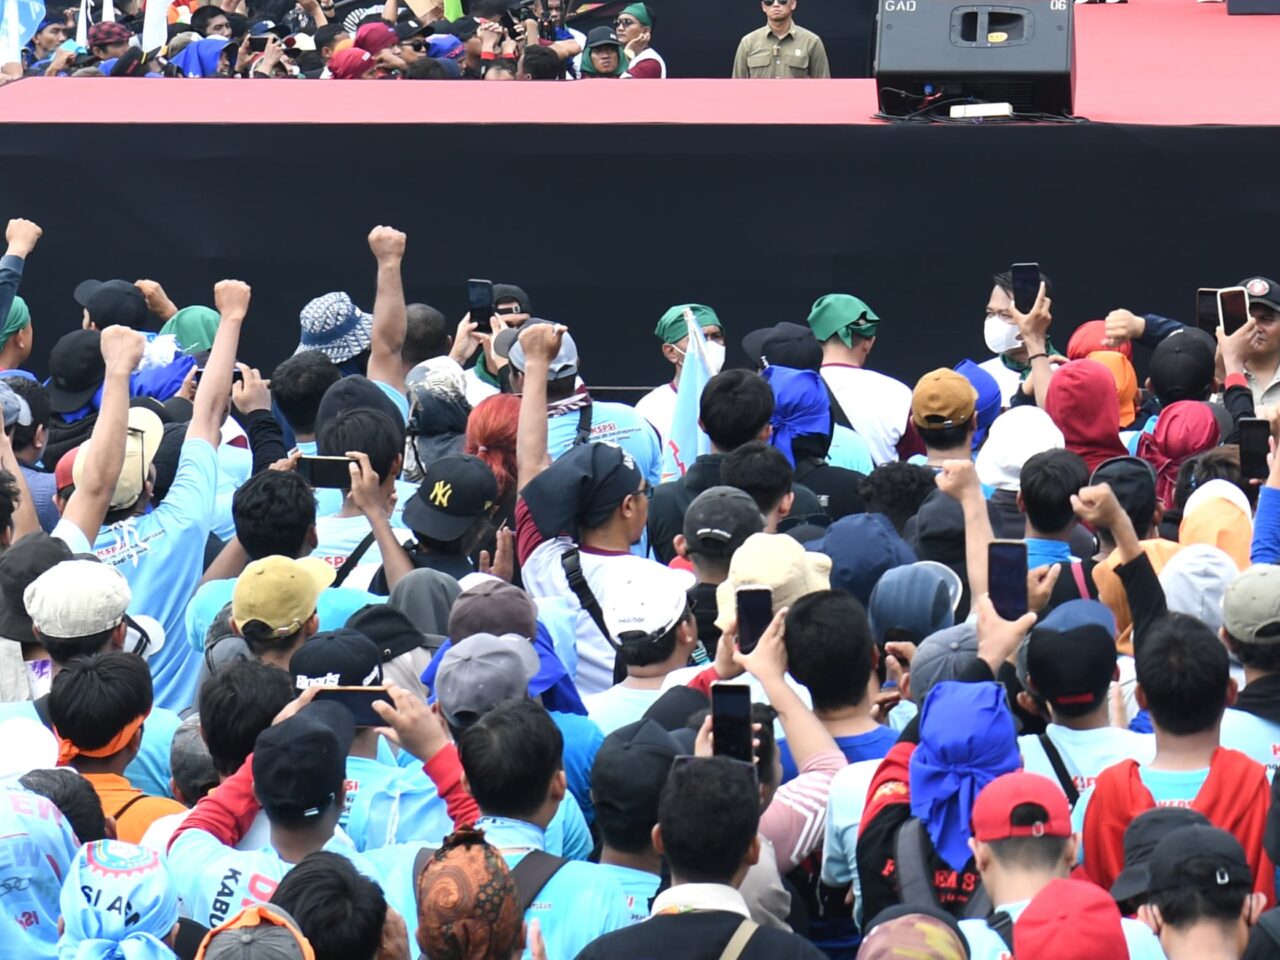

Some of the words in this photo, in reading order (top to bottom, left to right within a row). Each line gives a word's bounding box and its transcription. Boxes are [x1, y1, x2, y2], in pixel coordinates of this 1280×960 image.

[885, 0, 916, 11] GAD
[1050, 0, 1067, 10] 06
[429, 480, 452, 507] NY
